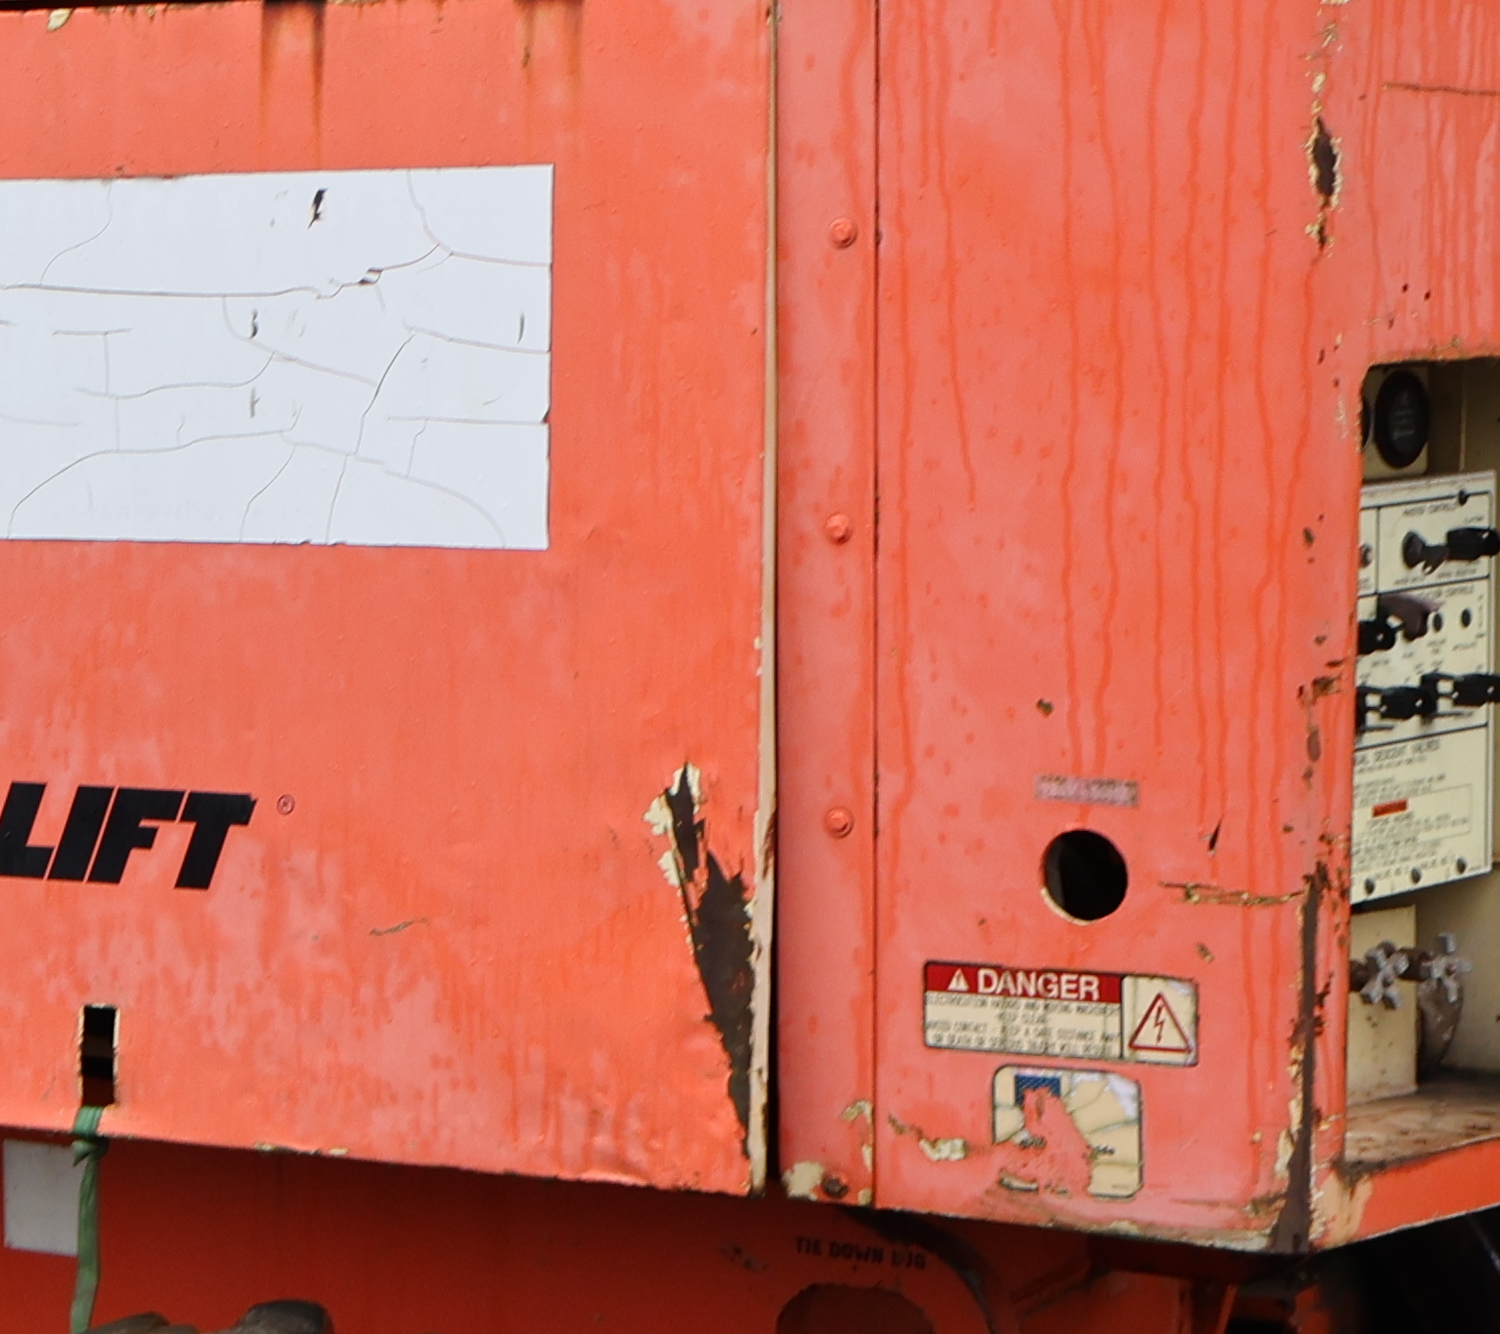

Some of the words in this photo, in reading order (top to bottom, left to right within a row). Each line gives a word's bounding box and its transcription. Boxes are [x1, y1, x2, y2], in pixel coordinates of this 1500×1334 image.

[977, 968, 1100, 1001] DANGER
[795, 1235, 822, 1256] TIE
[829, 1240, 884, 1264] DOWN
